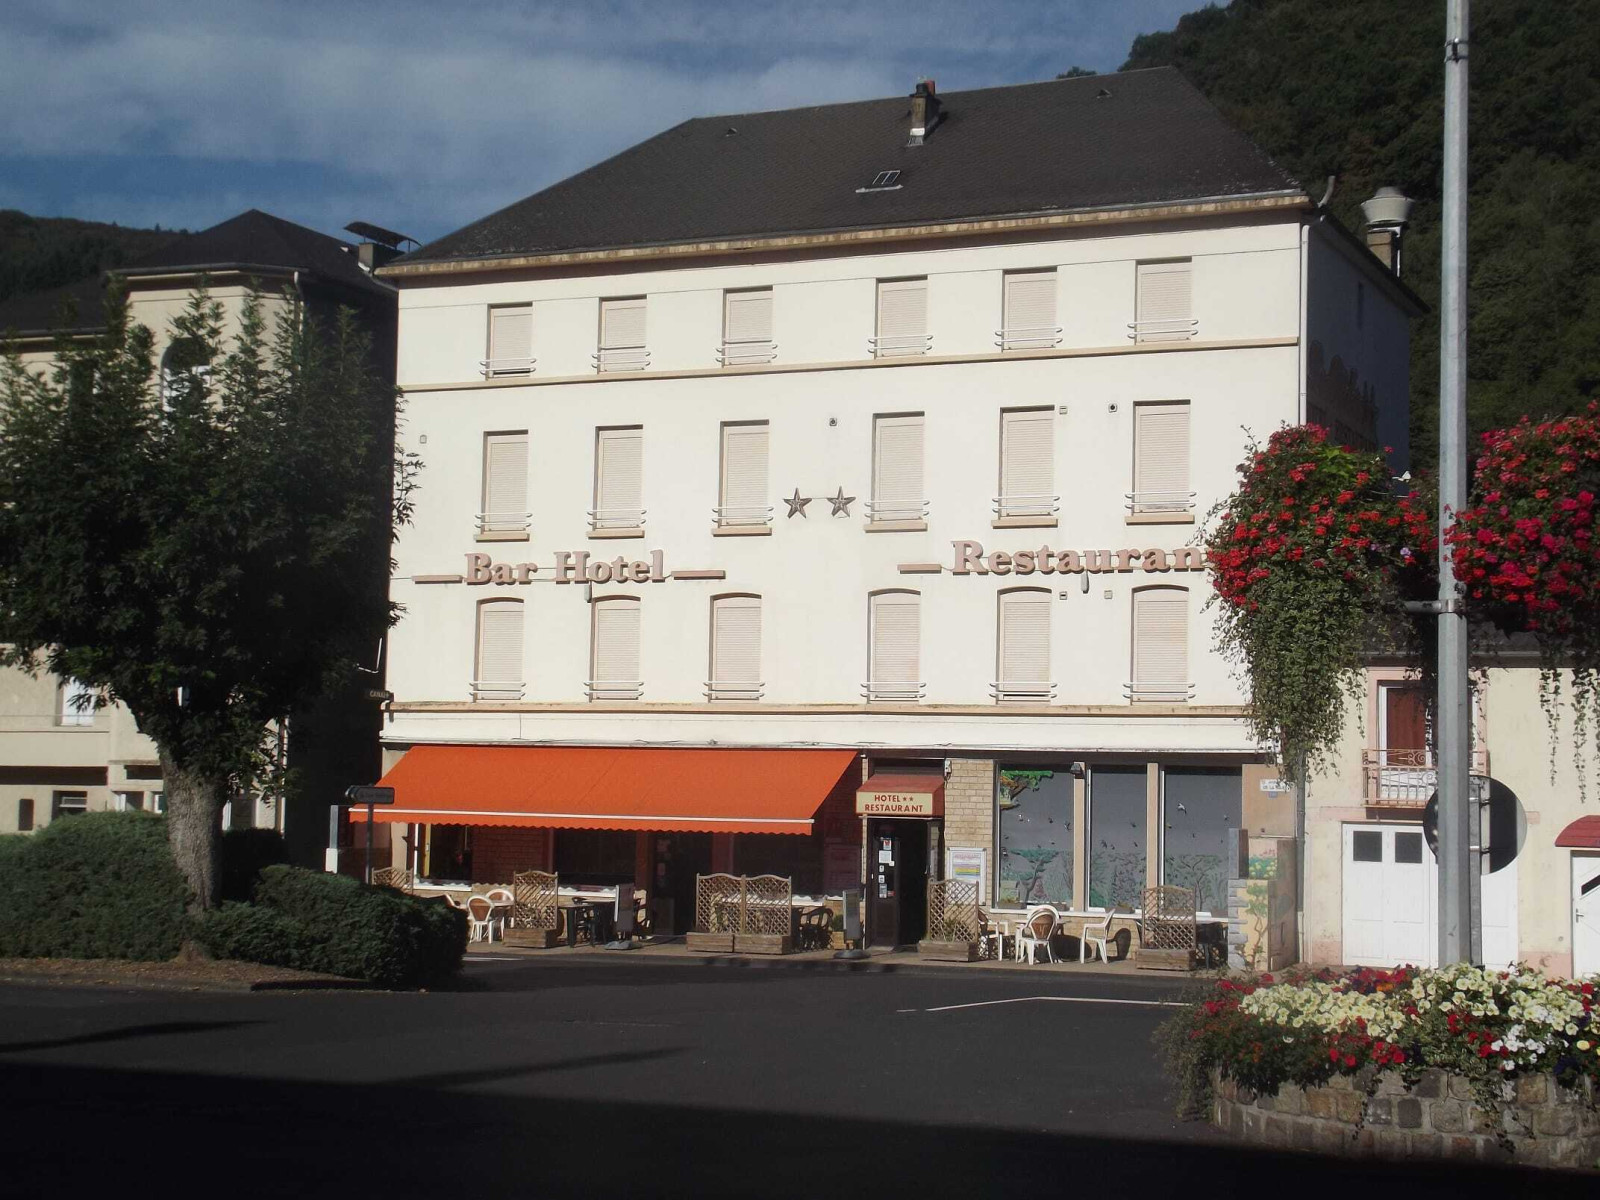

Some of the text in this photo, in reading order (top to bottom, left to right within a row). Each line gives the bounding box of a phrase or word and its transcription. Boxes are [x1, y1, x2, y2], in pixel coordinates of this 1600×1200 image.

[464, 549, 665, 585] Bar Hotel
[951, 540, 1213, 575] Restauran
[864, 803, 923, 812] RESTAURANT
[874, 794, 901, 802] HOTEL
